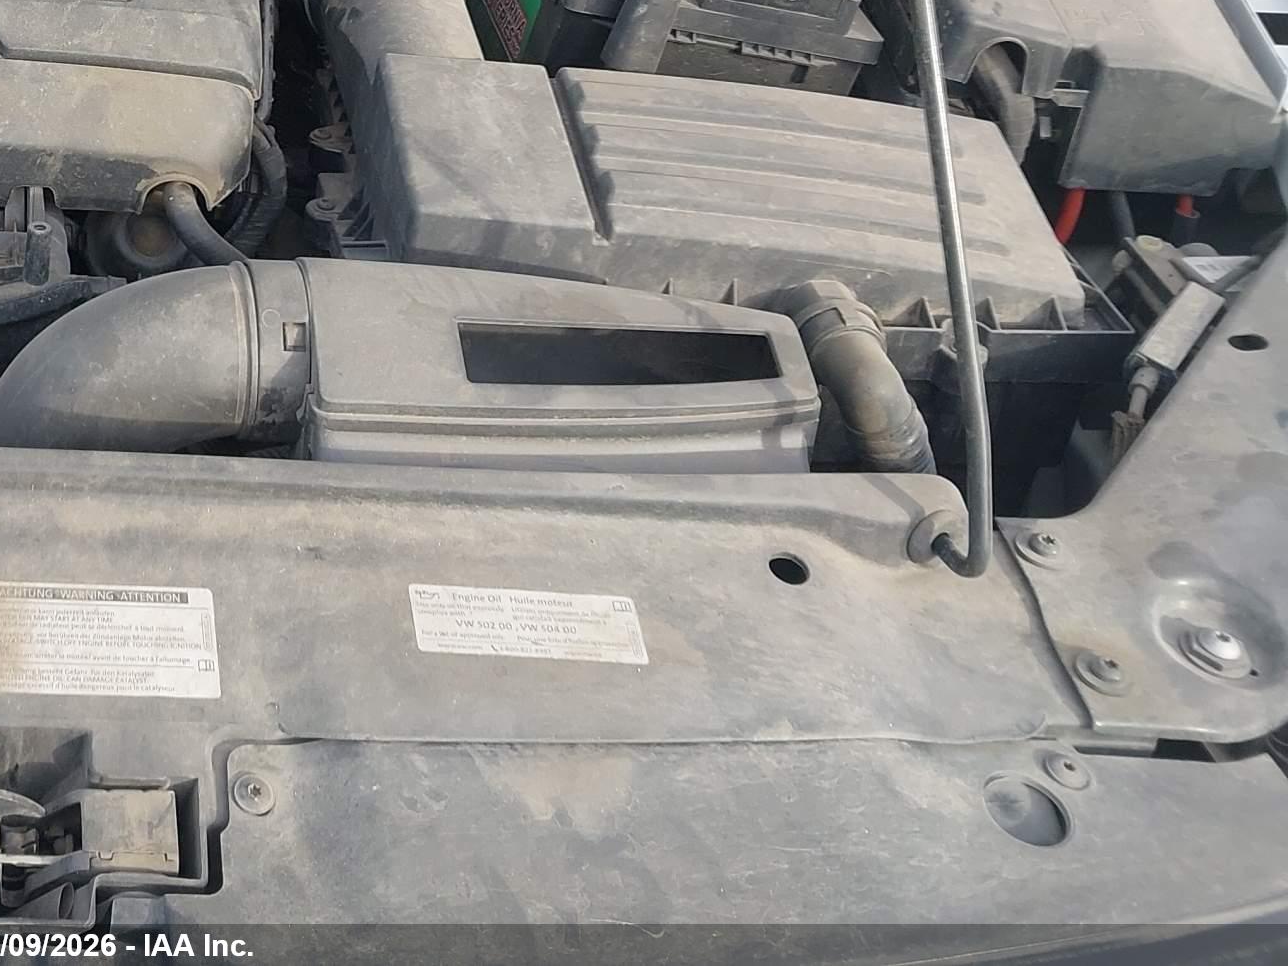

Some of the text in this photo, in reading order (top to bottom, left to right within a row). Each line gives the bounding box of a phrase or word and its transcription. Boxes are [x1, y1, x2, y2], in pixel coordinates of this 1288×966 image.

[0, 587, 182, 603] ACHTUNG WARNING ATTENTION
[452, 592, 573, 608] Engine Oil Huile moteur
[456, 619, 474, 628] VW
[477, 621, 495, 629] 502
[520, 623, 538, 632] VW
[541, 625, 560, 633] 504
[563, 626, 578, 635] 00
